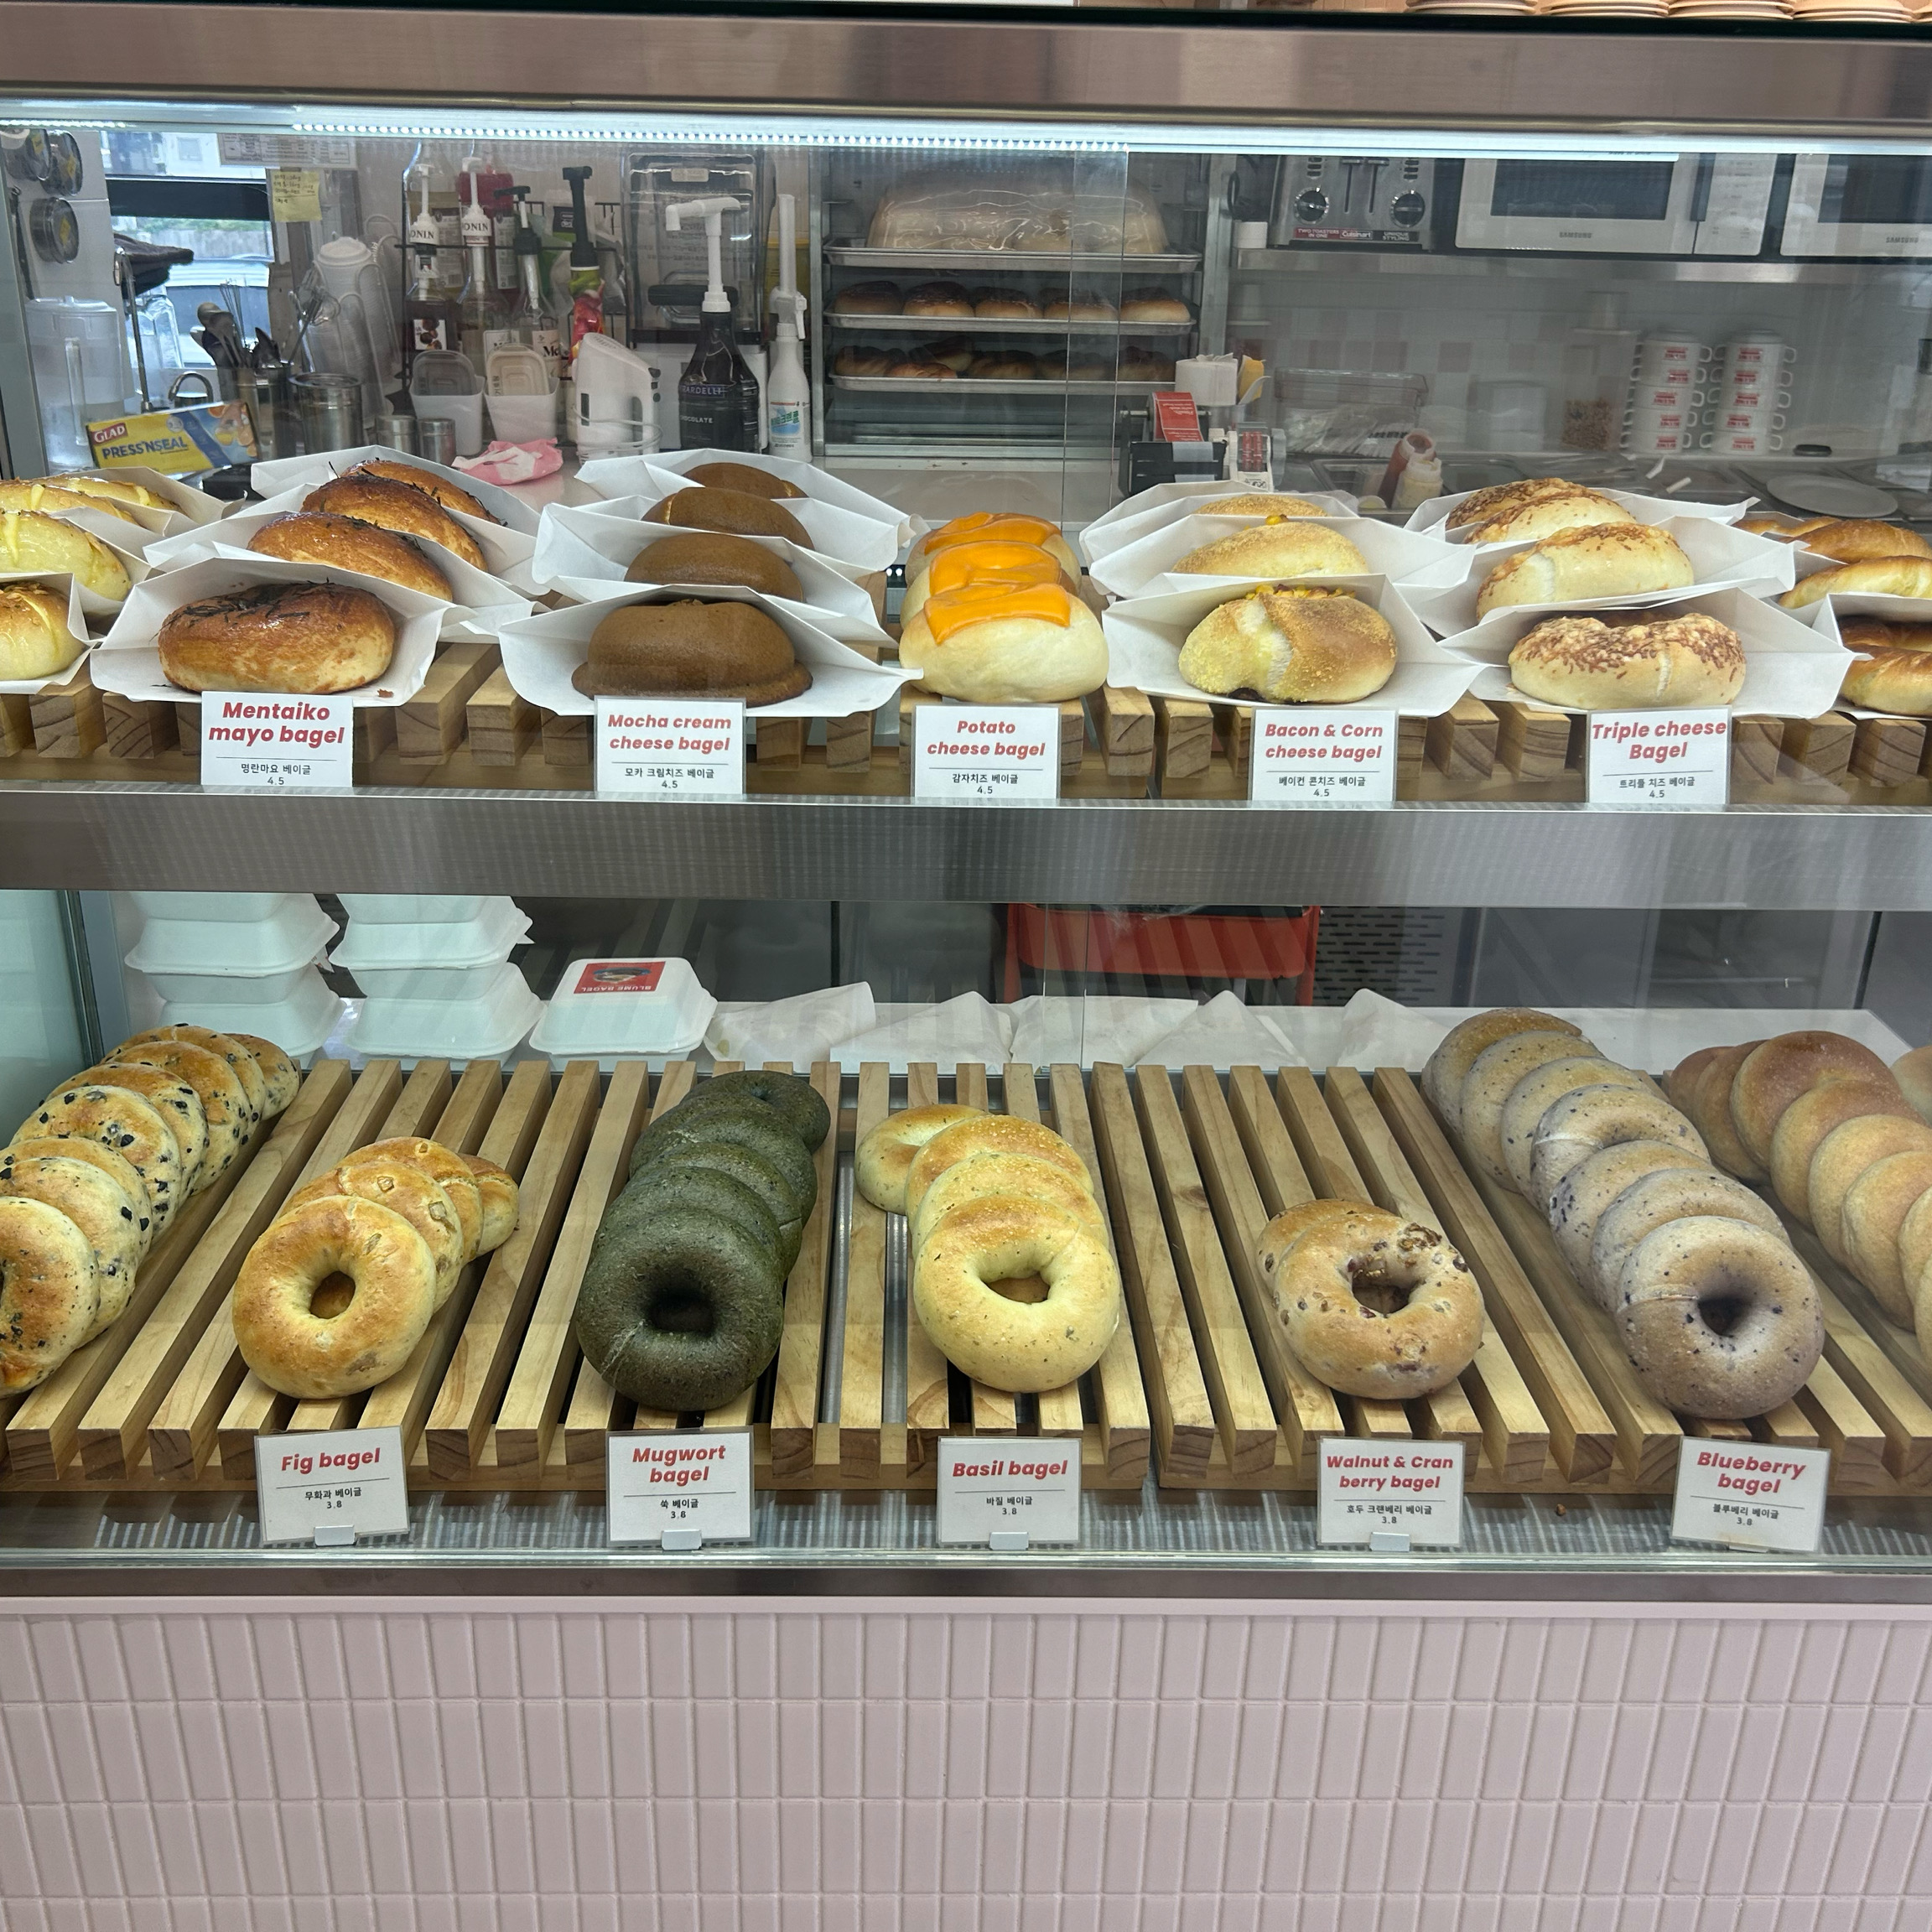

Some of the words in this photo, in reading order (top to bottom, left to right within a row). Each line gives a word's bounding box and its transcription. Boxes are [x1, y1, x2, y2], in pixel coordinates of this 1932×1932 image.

[1342, 230, 1371, 238] Cuisinart
[94, 424, 126, 444] GLAD
[222, 702, 330, 720] Mentaiko
[608, 714, 668, 728] Mocha
[673, 717, 731, 729] cream
[957, 720, 1015, 734] Potato
[209, 727, 274, 747] mayo
[279, 725, 345, 749] bagel
[1265, 724, 1320, 737] Bacon
[1323, 724, 1336, 737] &
[1341, 724, 1383, 737] Corn
[1592, 721, 1649, 744] Triple
[1654, 720, 1727, 737] cheese
[610, 735, 673, 750] cheese
[678, 736, 730, 755] bagel
[927, 741, 990, 755] cheese
[995, 742, 1046, 761] bagel
[1265, 745, 1327, 758] cheese
[1332, 745, 1382, 762] bagel
[1629, 741, 1688, 764] Bagel
[241, 763, 278, 774] 명란마요
[283, 765, 311, 775] 베이글
[625, 768, 643, 777] 모카
[647, 767, 683, 778] 크림치즈
[687, 769, 714, 779] 베이글
[267, 776, 284, 786] 4.5
[661, 781, 678, 789] 4.5
[953, 773, 988, 783] 감자치즈
[991, 774, 1019, 784] 베이글
[1279, 776, 1305, 787] 베이컨
[1309, 776, 1335, 786] 콘치즈
[1339, 776, 1366, 787] 베이글
[1619, 778, 1645, 788] 트리플
[1649, 778, 1665, 788] 치즈
[1669, 776, 1695, 787] 베이글
[977, 786, 993, 794] 4.5
[1313, 788, 1329, 797] 4.5
[1649, 790, 1665, 798] 4.5
[281, 1453, 313, 1474] Fig
[319, 1447, 381, 1471] bagel
[632, 1445, 726, 1467] Mugwort
[1327, 1455, 1389, 1468] Walnut
[1394, 1456, 1406, 1467] &
[1411, 1456, 1453, 1468] Cran
[953, 1460, 1005, 1477] Basil
[1008, 1460, 1068, 1480] bagel
[1696, 1452, 1807, 1480] Blueberry
[650, 1467, 709, 1487] bagel
[1339, 1475, 1387, 1492] berry
[1390, 1475, 1441, 1493] bagel
[1717, 1473, 1781, 1496] bagel
[305, 1489, 331, 1501] 무화과
[335, 1487, 362, 1498] 베이글
[326, 1500, 342, 1509] 3.8
[660, 1499, 669, 1509] 쑥
[673, 1498, 699, 1509] 베이글
[986, 1497, 1003, 1506] 바질
[1006, 1496, 1033, 1506] 베이글
[670, 1510, 687, 1519] 3.8
[1347, 1504, 1363, 1514] 호두
[1368, 1505, 1403, 1514] 크랜베리
[1405, 1505, 1432, 1515] 베이글
[1712, 1504, 1749, 1516] 블루베리
[1752, 1509, 1779, 1519] 베이글
[1382, 1516, 1397, 1524] 3.8
[1736, 1517, 1753, 1526] 3.8
